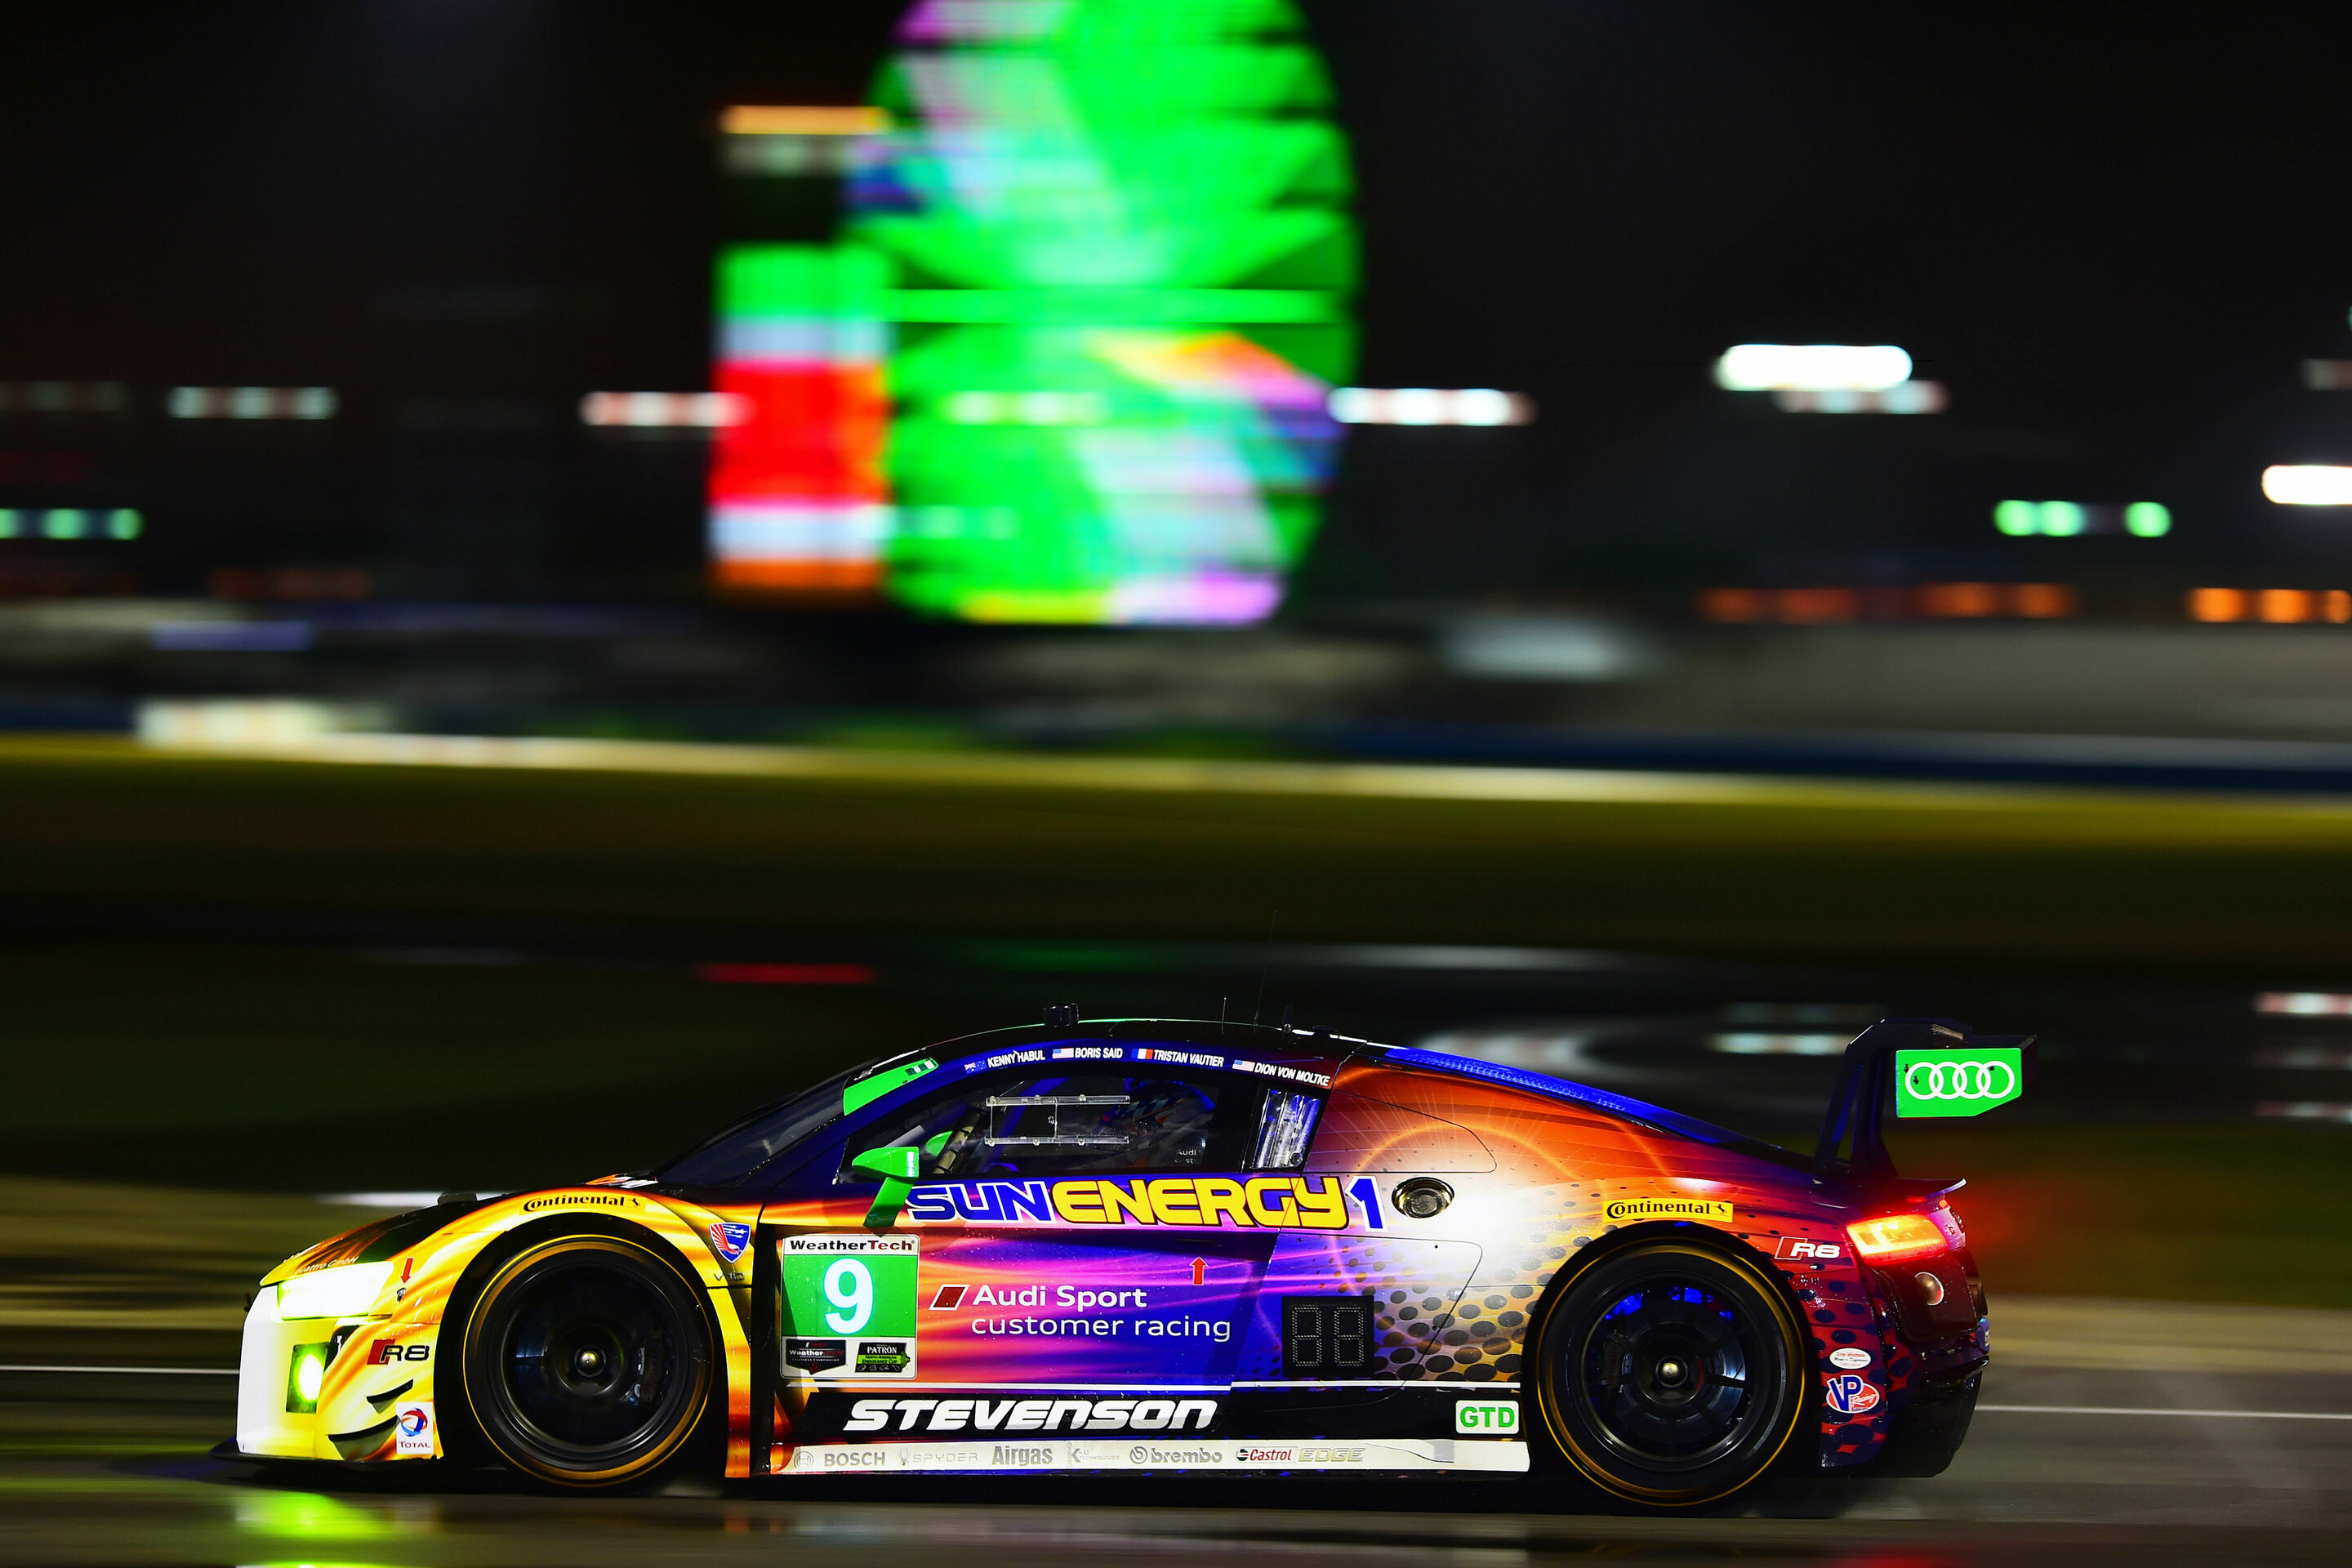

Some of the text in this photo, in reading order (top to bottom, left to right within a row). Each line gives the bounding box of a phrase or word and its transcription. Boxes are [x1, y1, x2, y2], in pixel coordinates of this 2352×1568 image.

[987, 1049, 1045, 1068] KENNY HABUL
[1074, 1048, 1123, 1059] BORIS SAID
[1153, 1049, 1224, 1067] TRISTAN VAUTIER
[1254, 1062, 1331, 1087] DION VON MOLTKE
[523, 1195, 625, 1213] Continental
[1606, 1200, 1710, 1219] Continental
[1789, 1241, 1840, 1258] R8
[823, 1258, 874, 1335] 9
[972, 1285, 1147, 1312] Audi Sport
[971, 1315, 1232, 1343] customer racing
[379, 1344, 430, 1362] R8
[1828, 1375, 1862, 1411] VP
[842, 1399, 1218, 1431] STEVENSON
[1459, 1405, 1516, 1428] GTD
[399, 1441, 431, 1449] TOTAL
[824, 1451, 886, 1467] BOSCH
[912, 1452, 978, 1463] SPYDER
[991, 1446, 1053, 1466] Airgas
[1151, 1447, 1223, 1463] brembo
[1250, 1447, 1366, 1463] Castrol EDGE
